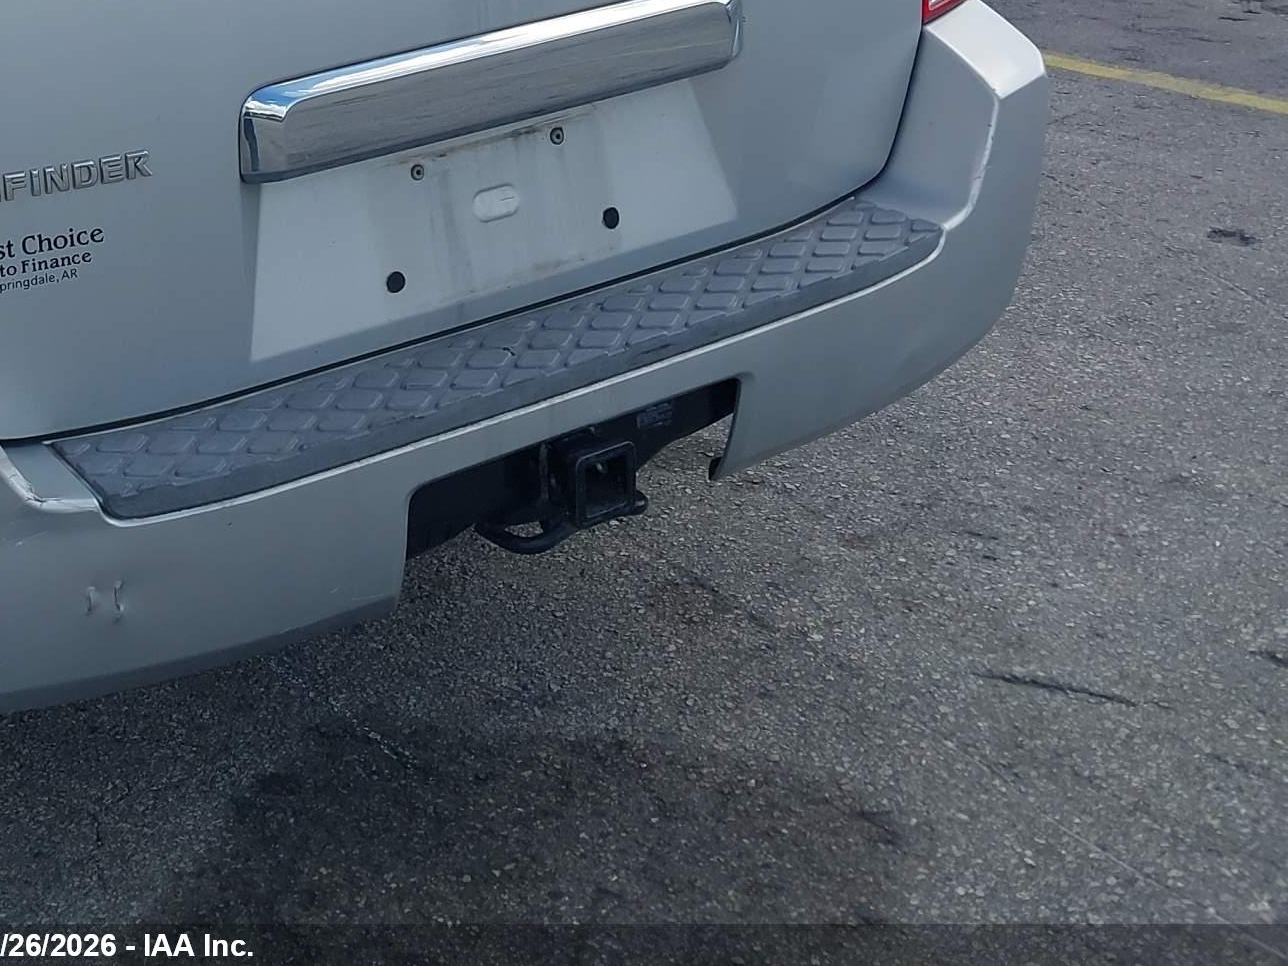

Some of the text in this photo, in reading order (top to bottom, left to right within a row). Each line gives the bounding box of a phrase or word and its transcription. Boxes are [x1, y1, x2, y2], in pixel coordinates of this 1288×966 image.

[21, 227, 105, 255] Choice
[21, 251, 92, 273] Finance
[61, 268, 78, 281] AR
